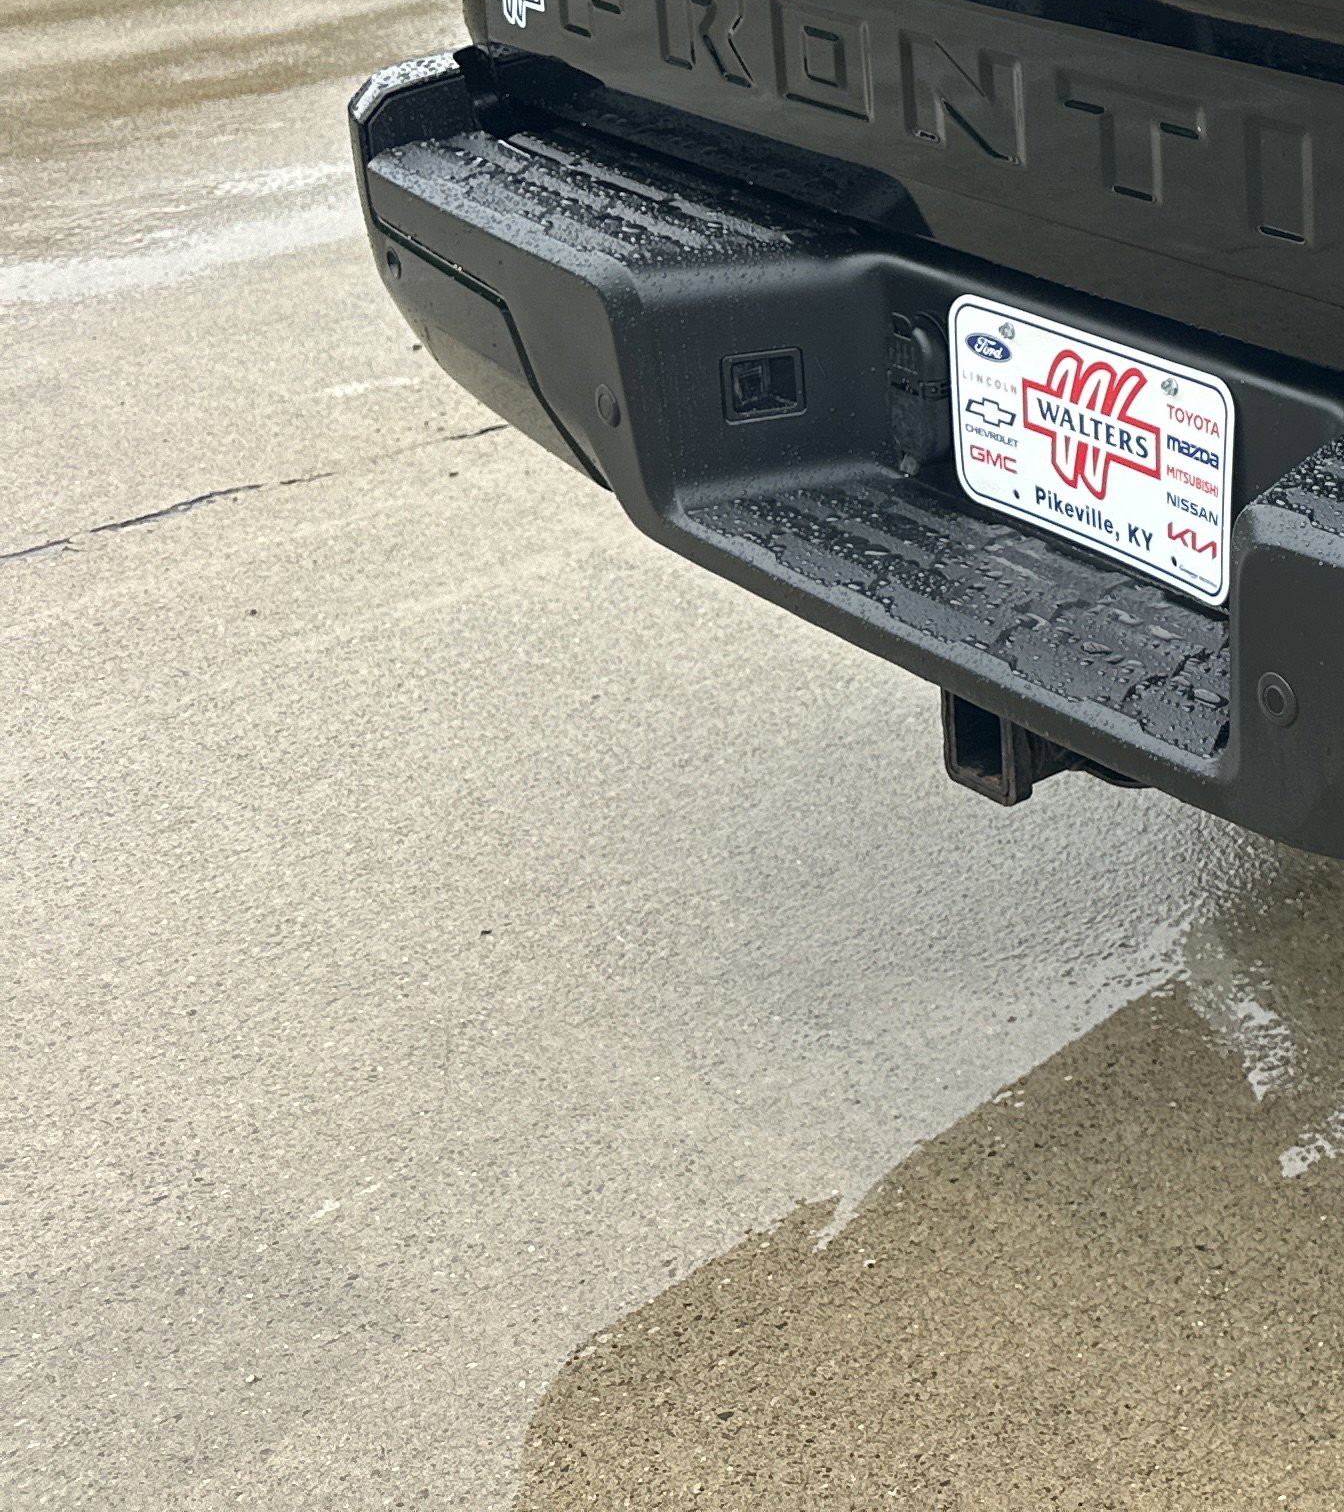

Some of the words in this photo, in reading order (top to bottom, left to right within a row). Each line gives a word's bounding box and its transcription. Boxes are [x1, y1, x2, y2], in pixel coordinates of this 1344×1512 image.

[962, 369, 1018, 395] LINCOLN
[964, 423, 1019, 448] CHEVROLET
[1036, 397, 1150, 460] WALTERS
[1166, 403, 1221, 439] TOYOTA
[969, 444, 1018, 474] GMC
[1166, 464, 1219, 499] MITSUBISHI
[1035, 484, 1121, 543] Pikeville,
[1127, 521, 1154, 552] KY
[1166, 491, 1219, 526] NISSAN
